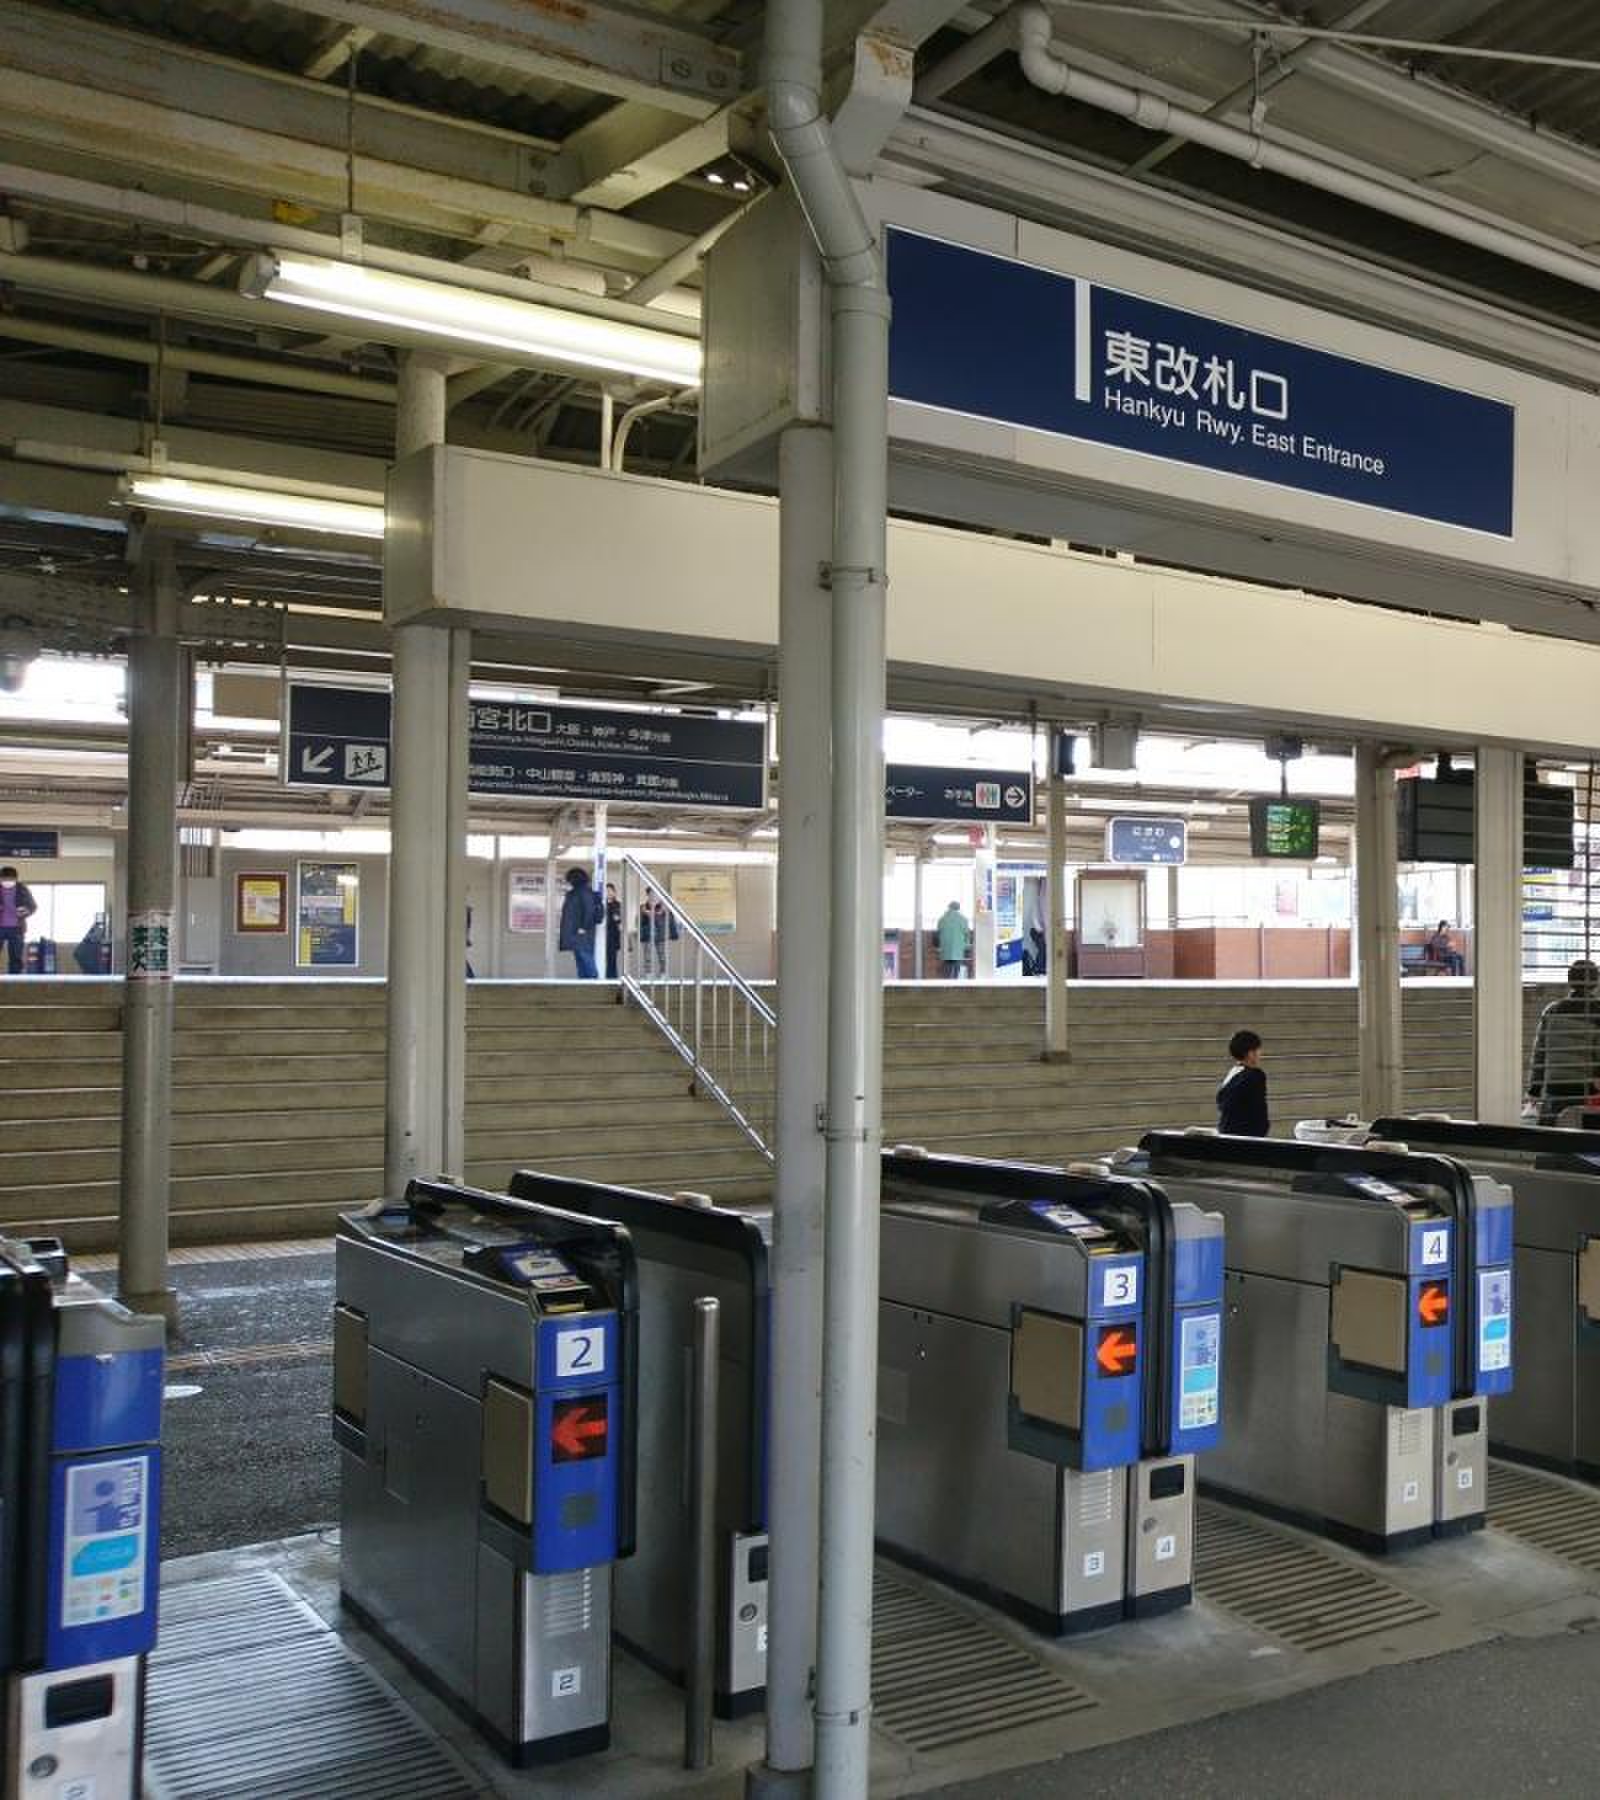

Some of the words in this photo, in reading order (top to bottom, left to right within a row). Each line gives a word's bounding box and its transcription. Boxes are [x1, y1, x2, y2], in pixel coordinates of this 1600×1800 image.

[1104, 330, 1288, 421] 東改札口
[1104, 387, 1186, 427] Hankyu
[1196, 410, 1246, 446] Rwy.
[1252, 424, 1296, 454] East
[1302, 436, 1385, 476] Entrance
[1429, 1235, 1443, 1259] 4
[1114, 1273, 1129, 1300] 3
[570, 1336, 593, 1369] 2
[559, 1673, 575, 1691] 2
